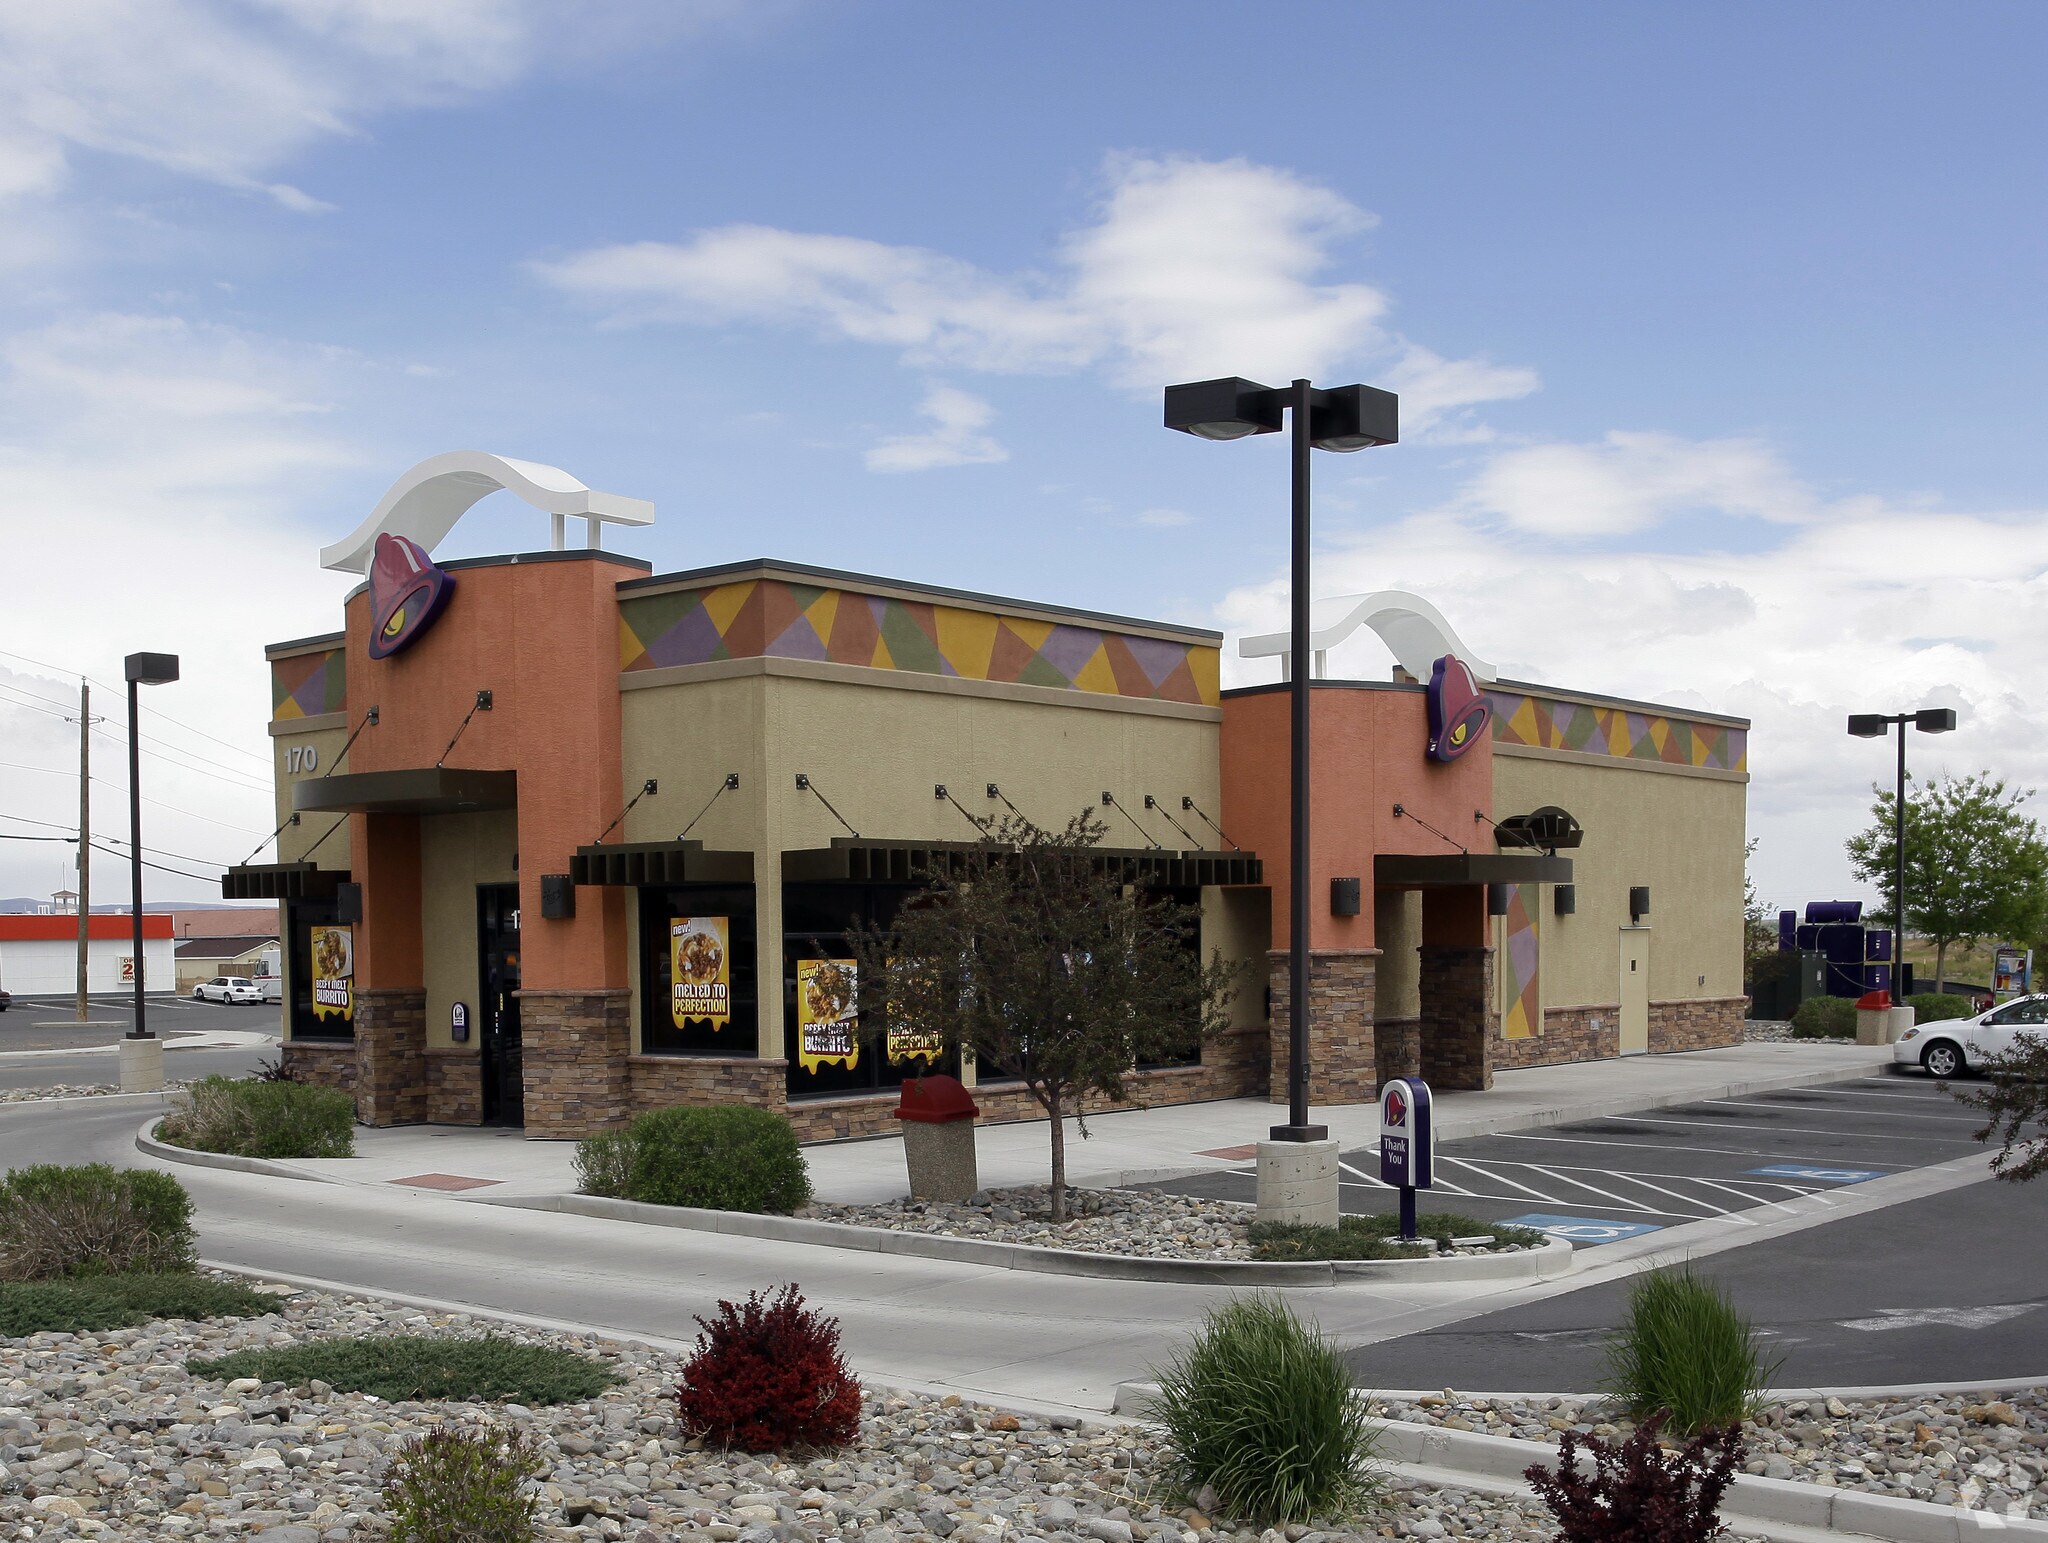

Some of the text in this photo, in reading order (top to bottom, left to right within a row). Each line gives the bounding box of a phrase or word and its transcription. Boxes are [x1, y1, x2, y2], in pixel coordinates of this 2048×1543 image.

[285, 745, 317, 773] 170
[673, 920, 691, 936] new!
[800, 963, 819, 979] new!
[316, 989, 348, 1006] BURRITO
[675, 983, 726, 998] MELTED TO
[675, 998, 726, 1013] PERFECTION
[1384, 1137, 1406, 1152] Thank
[1388, 1151, 1402, 1165] You
